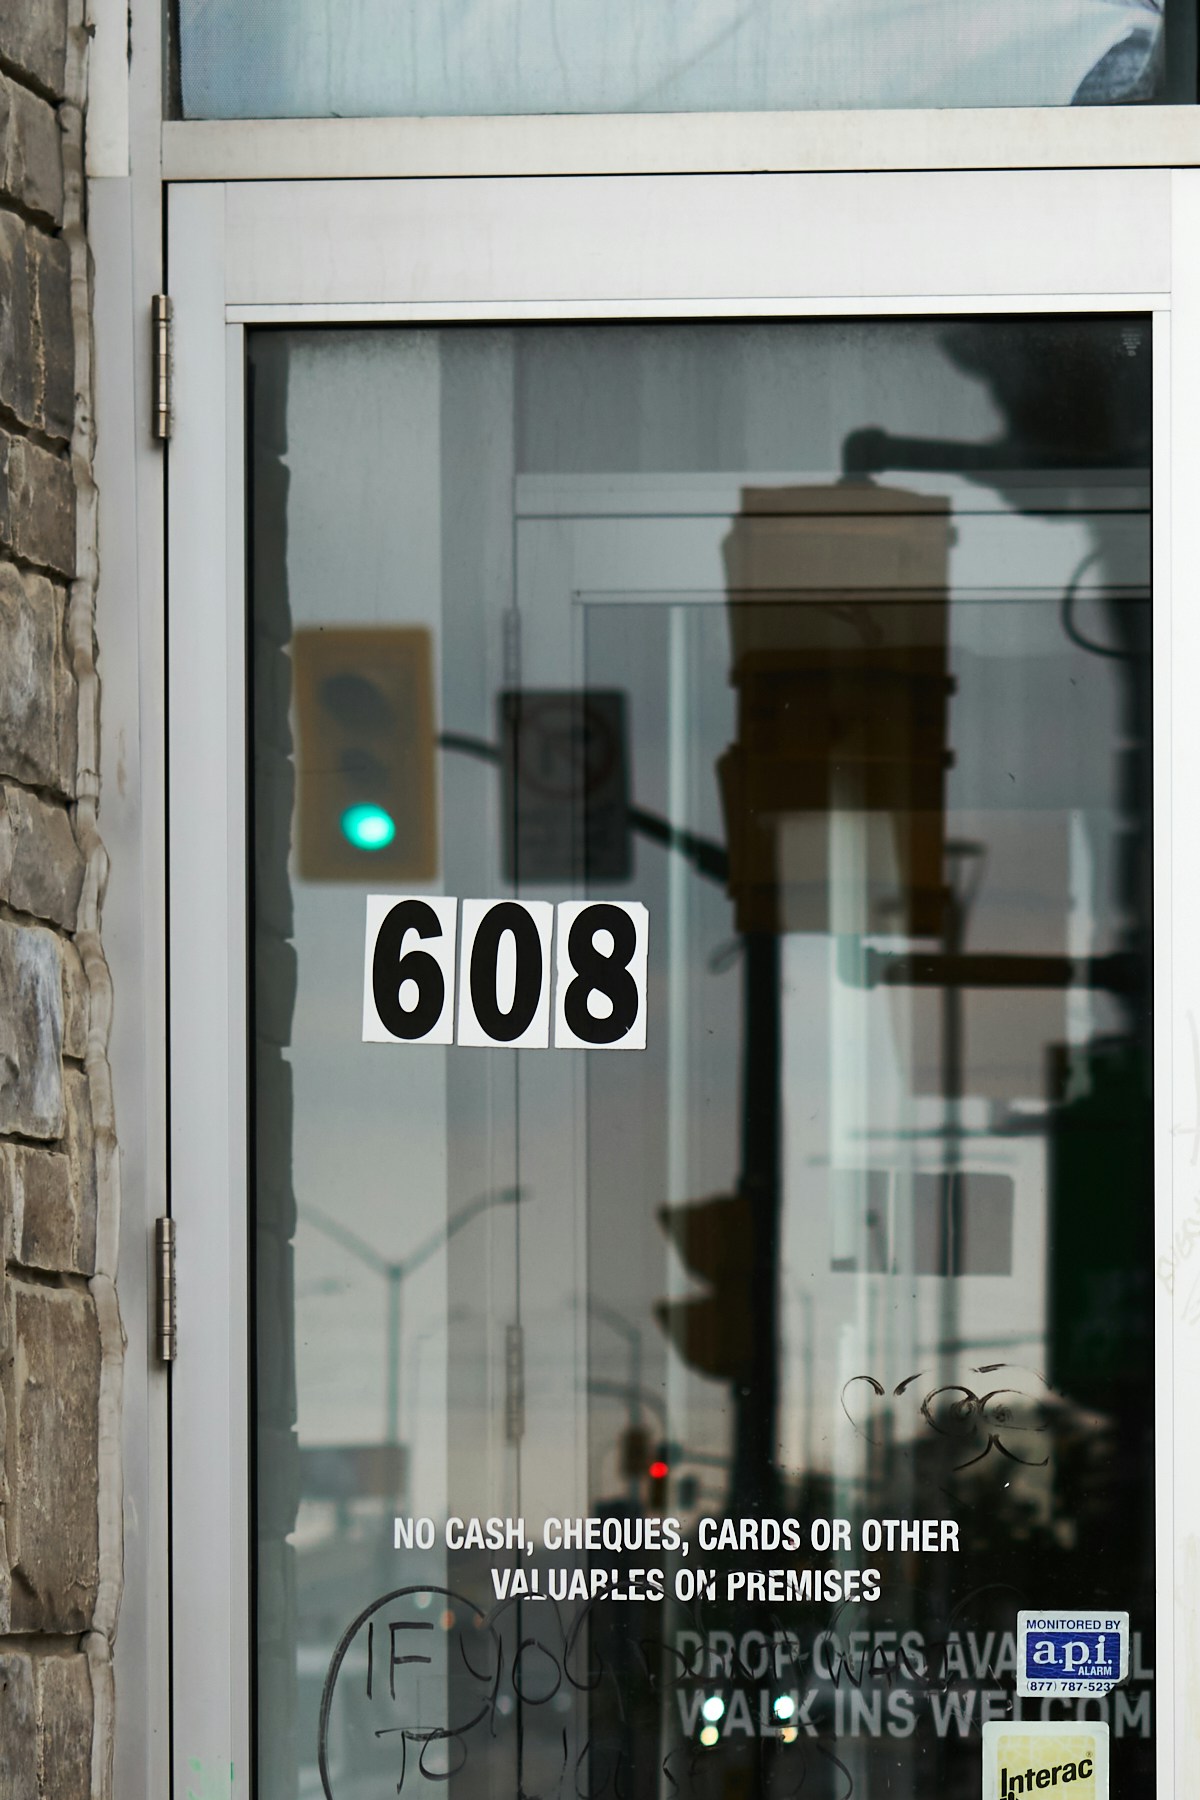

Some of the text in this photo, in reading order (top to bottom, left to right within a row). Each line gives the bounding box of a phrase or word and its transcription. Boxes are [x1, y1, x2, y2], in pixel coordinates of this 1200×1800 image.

[372, 899, 638, 1044] 608
[394, 1517, 960, 1557] NO CASH, CHEQUES, CARDS OR OTHER
[491, 1568, 882, 1602] VALUABLES ON PREMISES
[1026, 1619, 1121, 1630] MONITORED BY
[363, 1621, 436, 1701] IF
[675, 1631, 800, 1681] DROP
[812, 1631, 924, 1679] OFFS
[1032, 1634, 1113, 1672] a.p.i.
[1078, 1666, 1112, 1676] ALARM
[1026, 1681, 1057, 1693] (877)
[675, 1688, 820, 1739] WALK
[835, 1688, 918, 1738] INS
[1001, 1757, 1093, 1798] Interac
